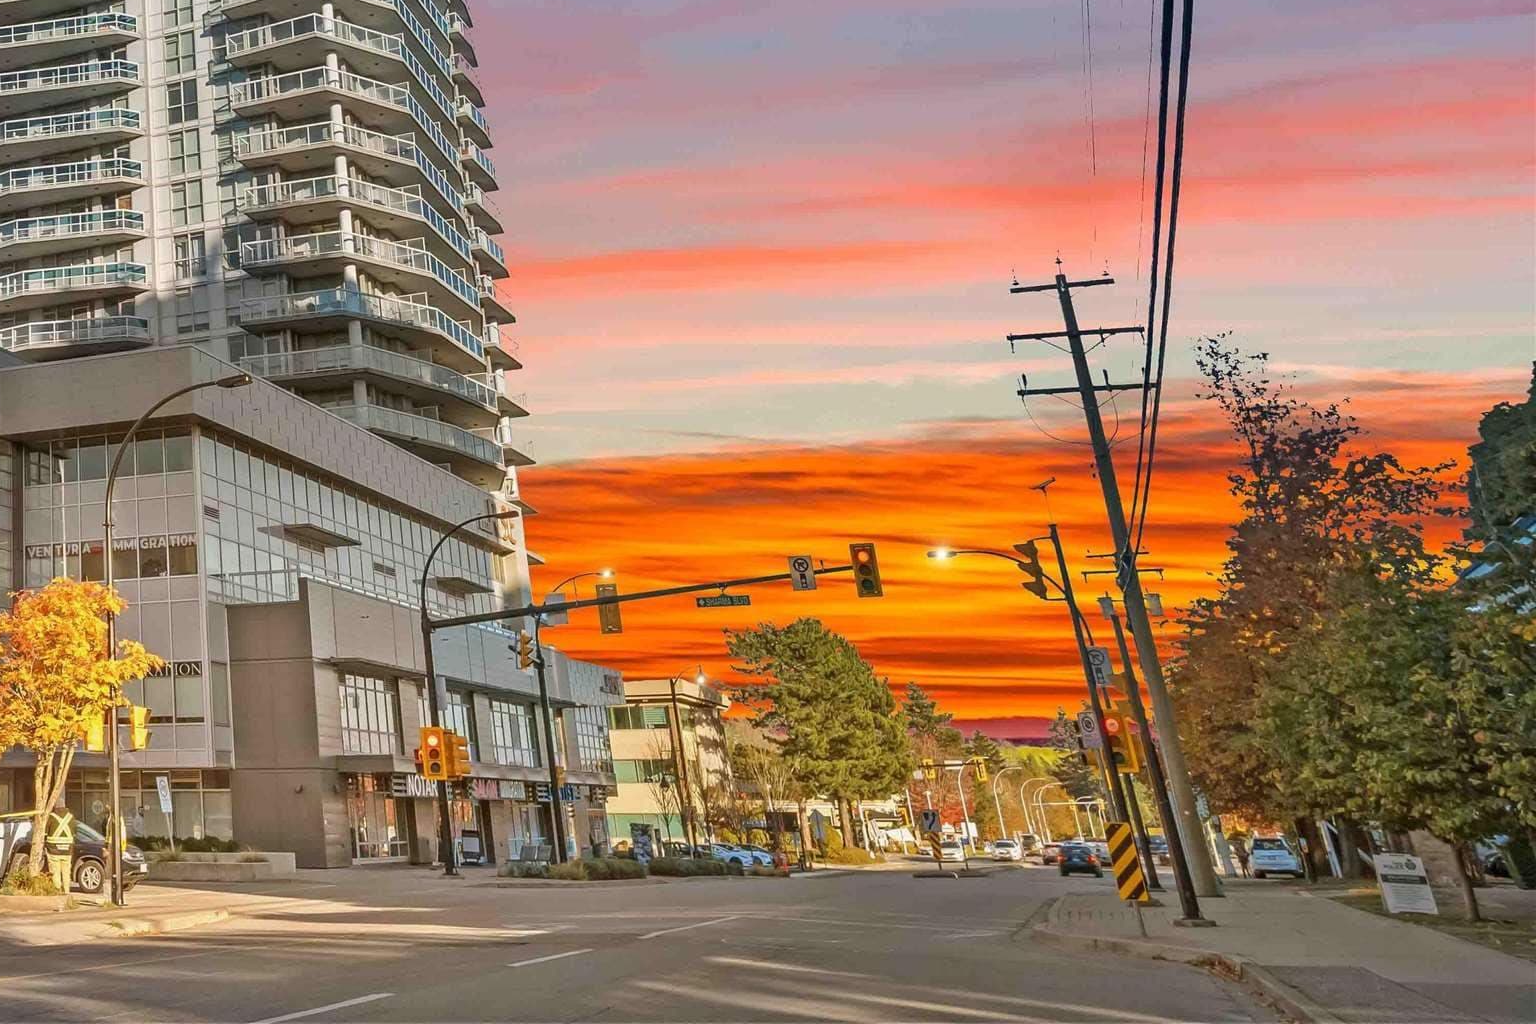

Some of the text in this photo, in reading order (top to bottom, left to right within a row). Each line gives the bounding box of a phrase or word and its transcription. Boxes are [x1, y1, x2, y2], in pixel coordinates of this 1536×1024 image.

[27, 535, 198, 557] VENTURA MMIGRATION
[407, 774, 439, 797] NOTAR
